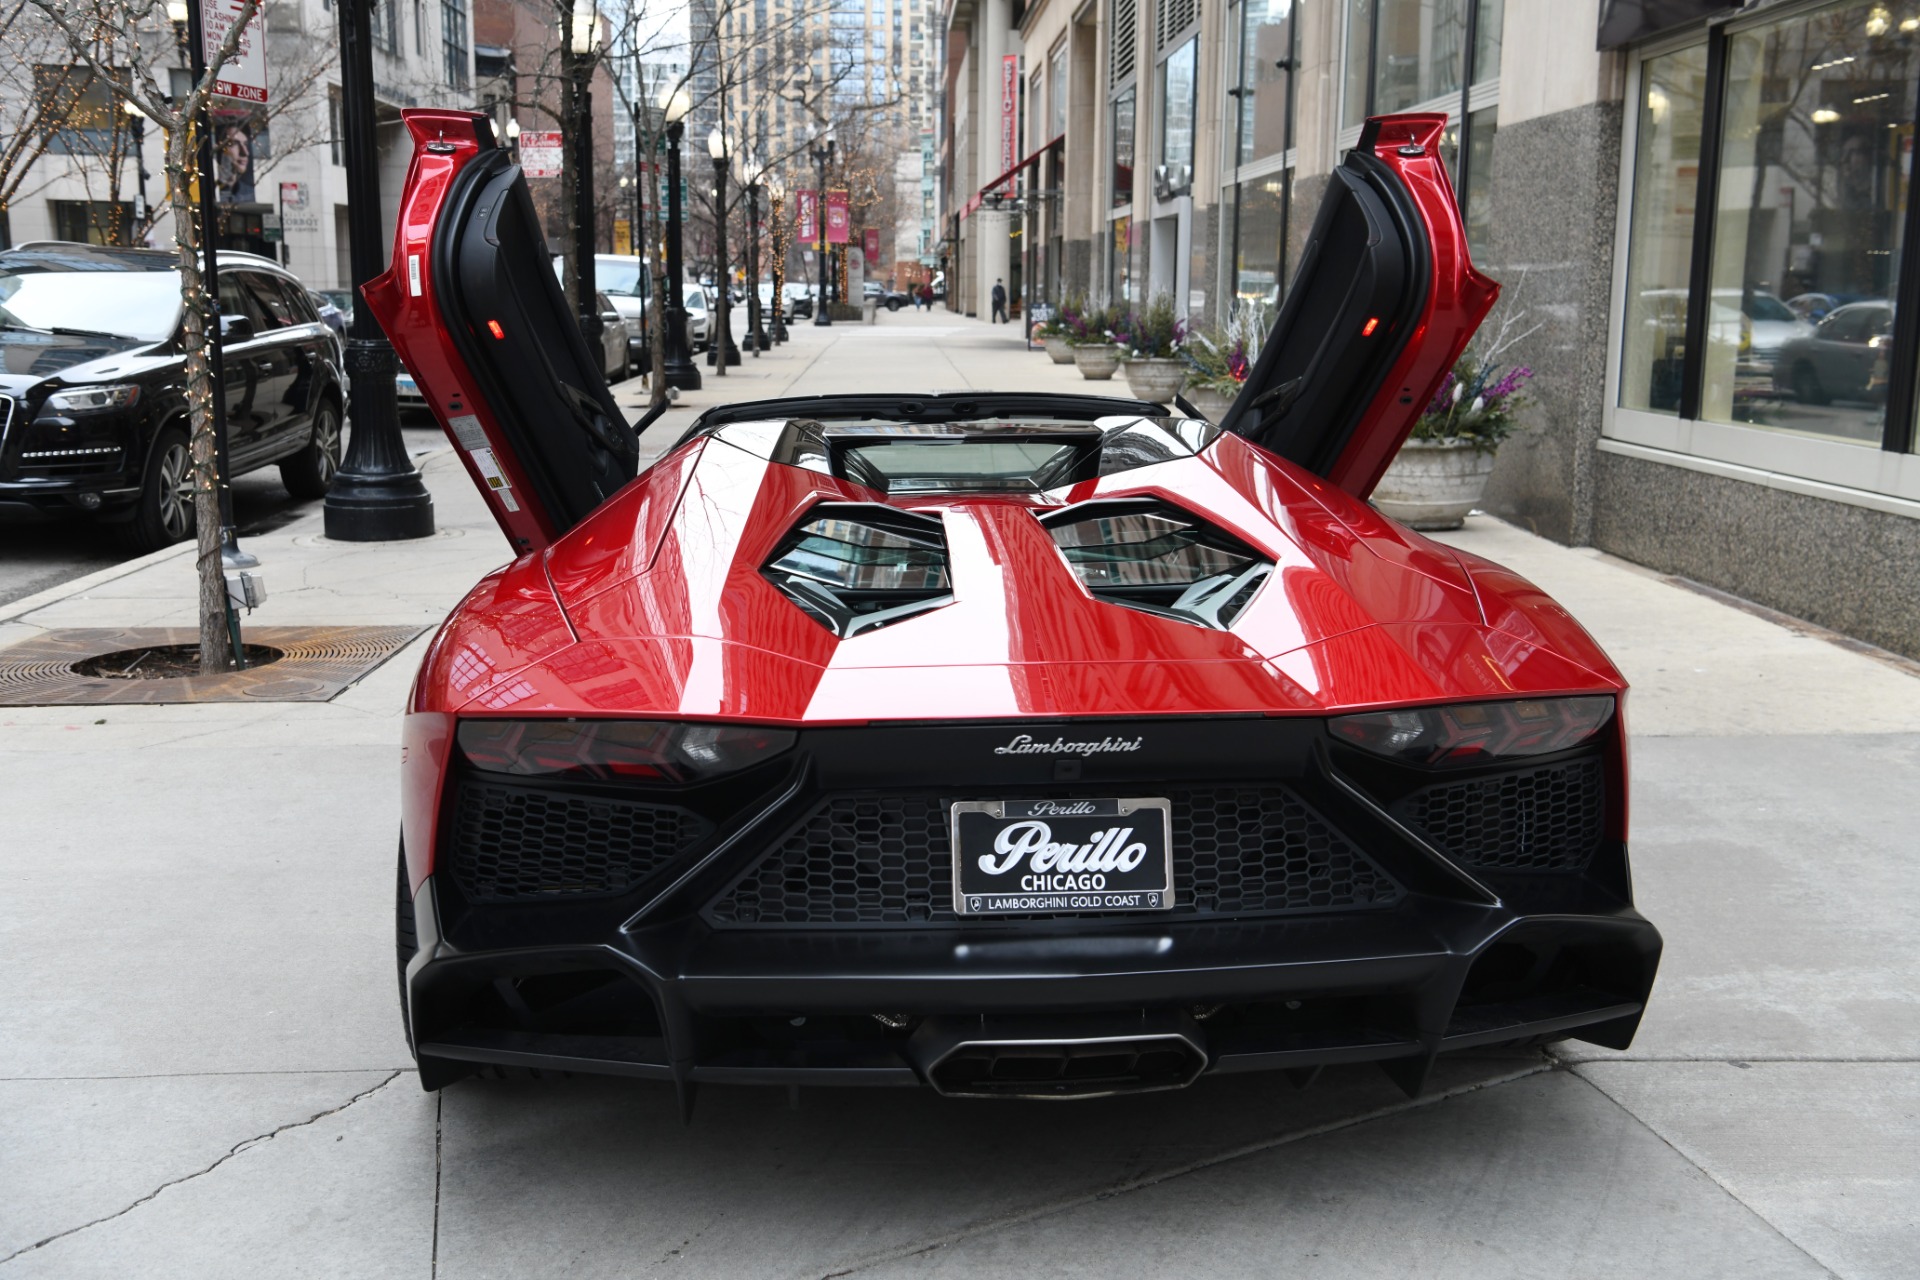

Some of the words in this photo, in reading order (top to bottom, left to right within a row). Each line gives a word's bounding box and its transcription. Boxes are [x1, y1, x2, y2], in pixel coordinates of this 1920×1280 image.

[204, 0, 218, 10] USE
[214, 22, 225, 31] AM
[206, 30, 222, 41] MON
[236, 85, 264, 101] ZONE
[994, 734, 1143, 757] Lamborghini
[1027, 801, 1096, 816] Perillo
[977, 820, 1147, 875] Perillo
[1020, 874, 1106, 891] CHICAGO
[988, 897, 1068, 909] LAMBORGHINI
[1070, 896, 1100, 908] GOLD
[1106, 895, 1141, 907] COAST
